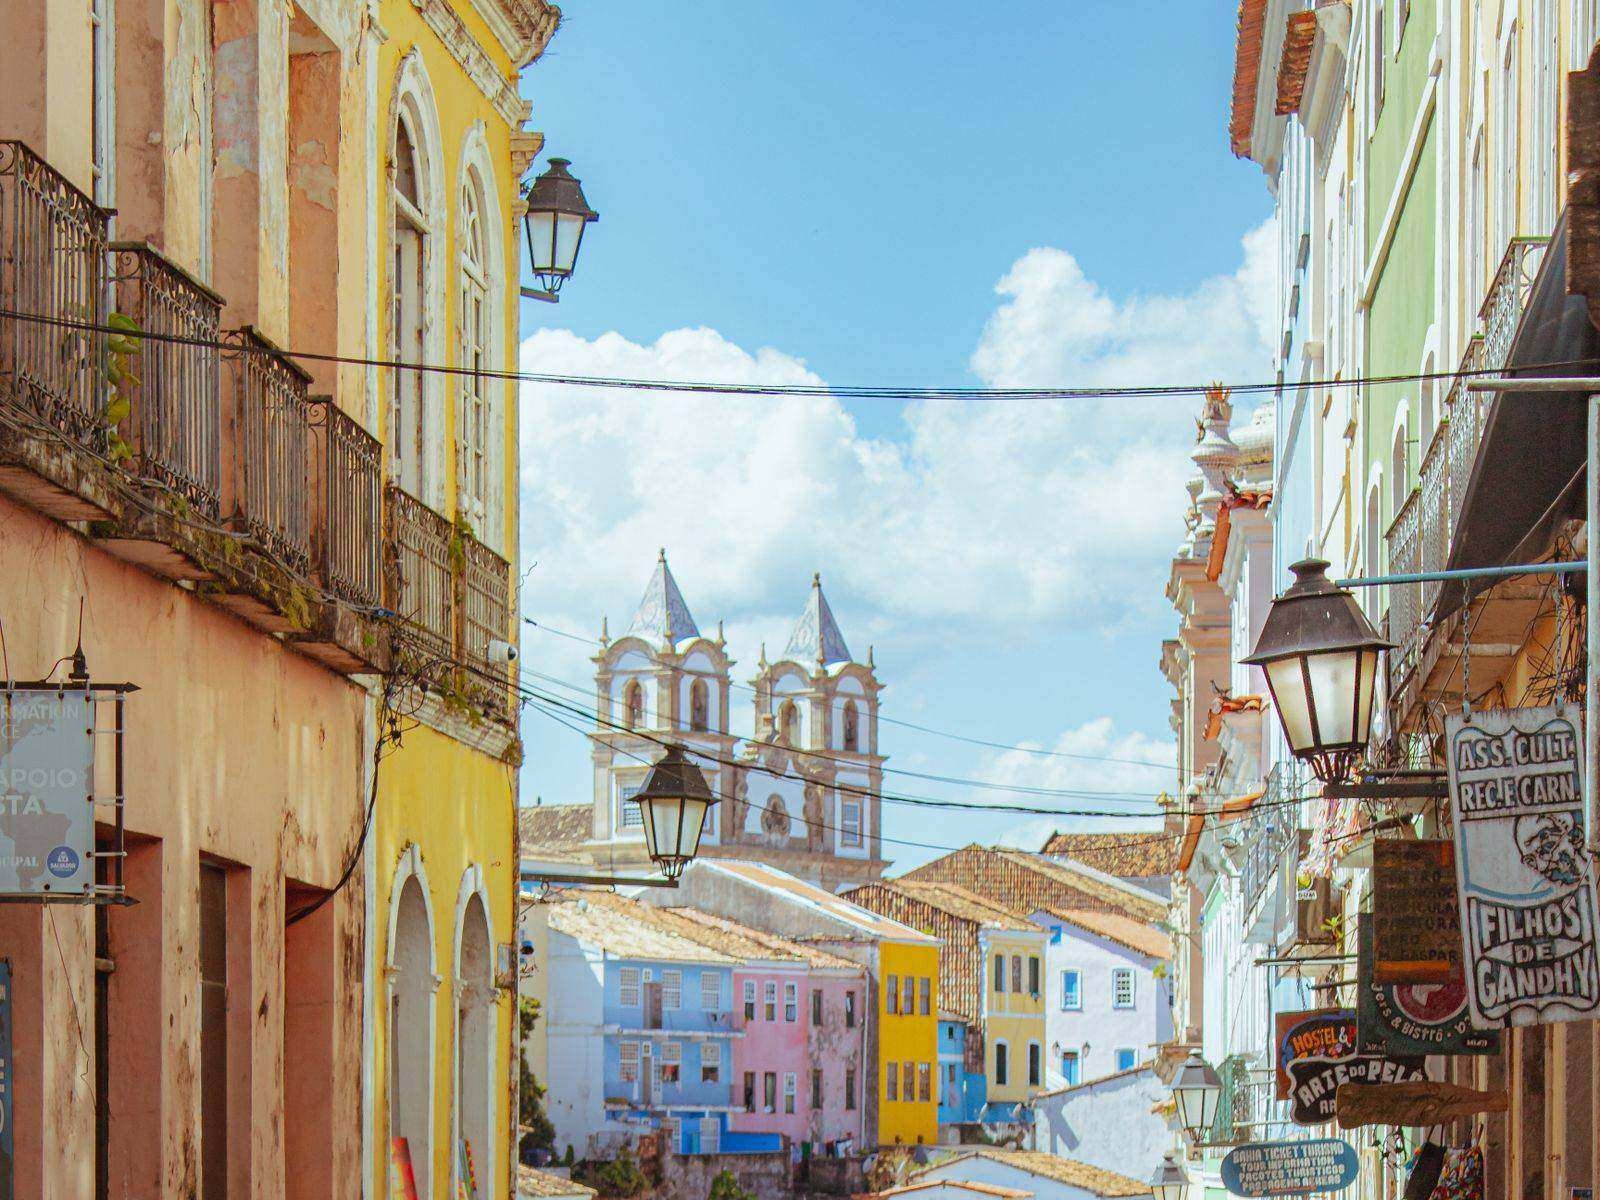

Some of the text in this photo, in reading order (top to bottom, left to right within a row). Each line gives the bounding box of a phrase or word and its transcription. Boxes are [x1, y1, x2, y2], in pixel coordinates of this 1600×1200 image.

[1515, 731, 1576, 765] CULT.
[1519, 772, 1580, 806] CARN.
[1480, 895, 1581, 949] FILHOS
[1514, 943, 1554, 964] DE
[1477, 945, 1593, 1008] GANDHY
[1293, 1026, 1338, 1054] HOSTEL
[1339, 1026, 1348, 1044] &
[1298, 1064, 1350, 1108] ARTE
[1350, 1065, 1366, 1077] DO
[1233, 1142, 1344, 1164] BAHIA TICKET TURISMO
